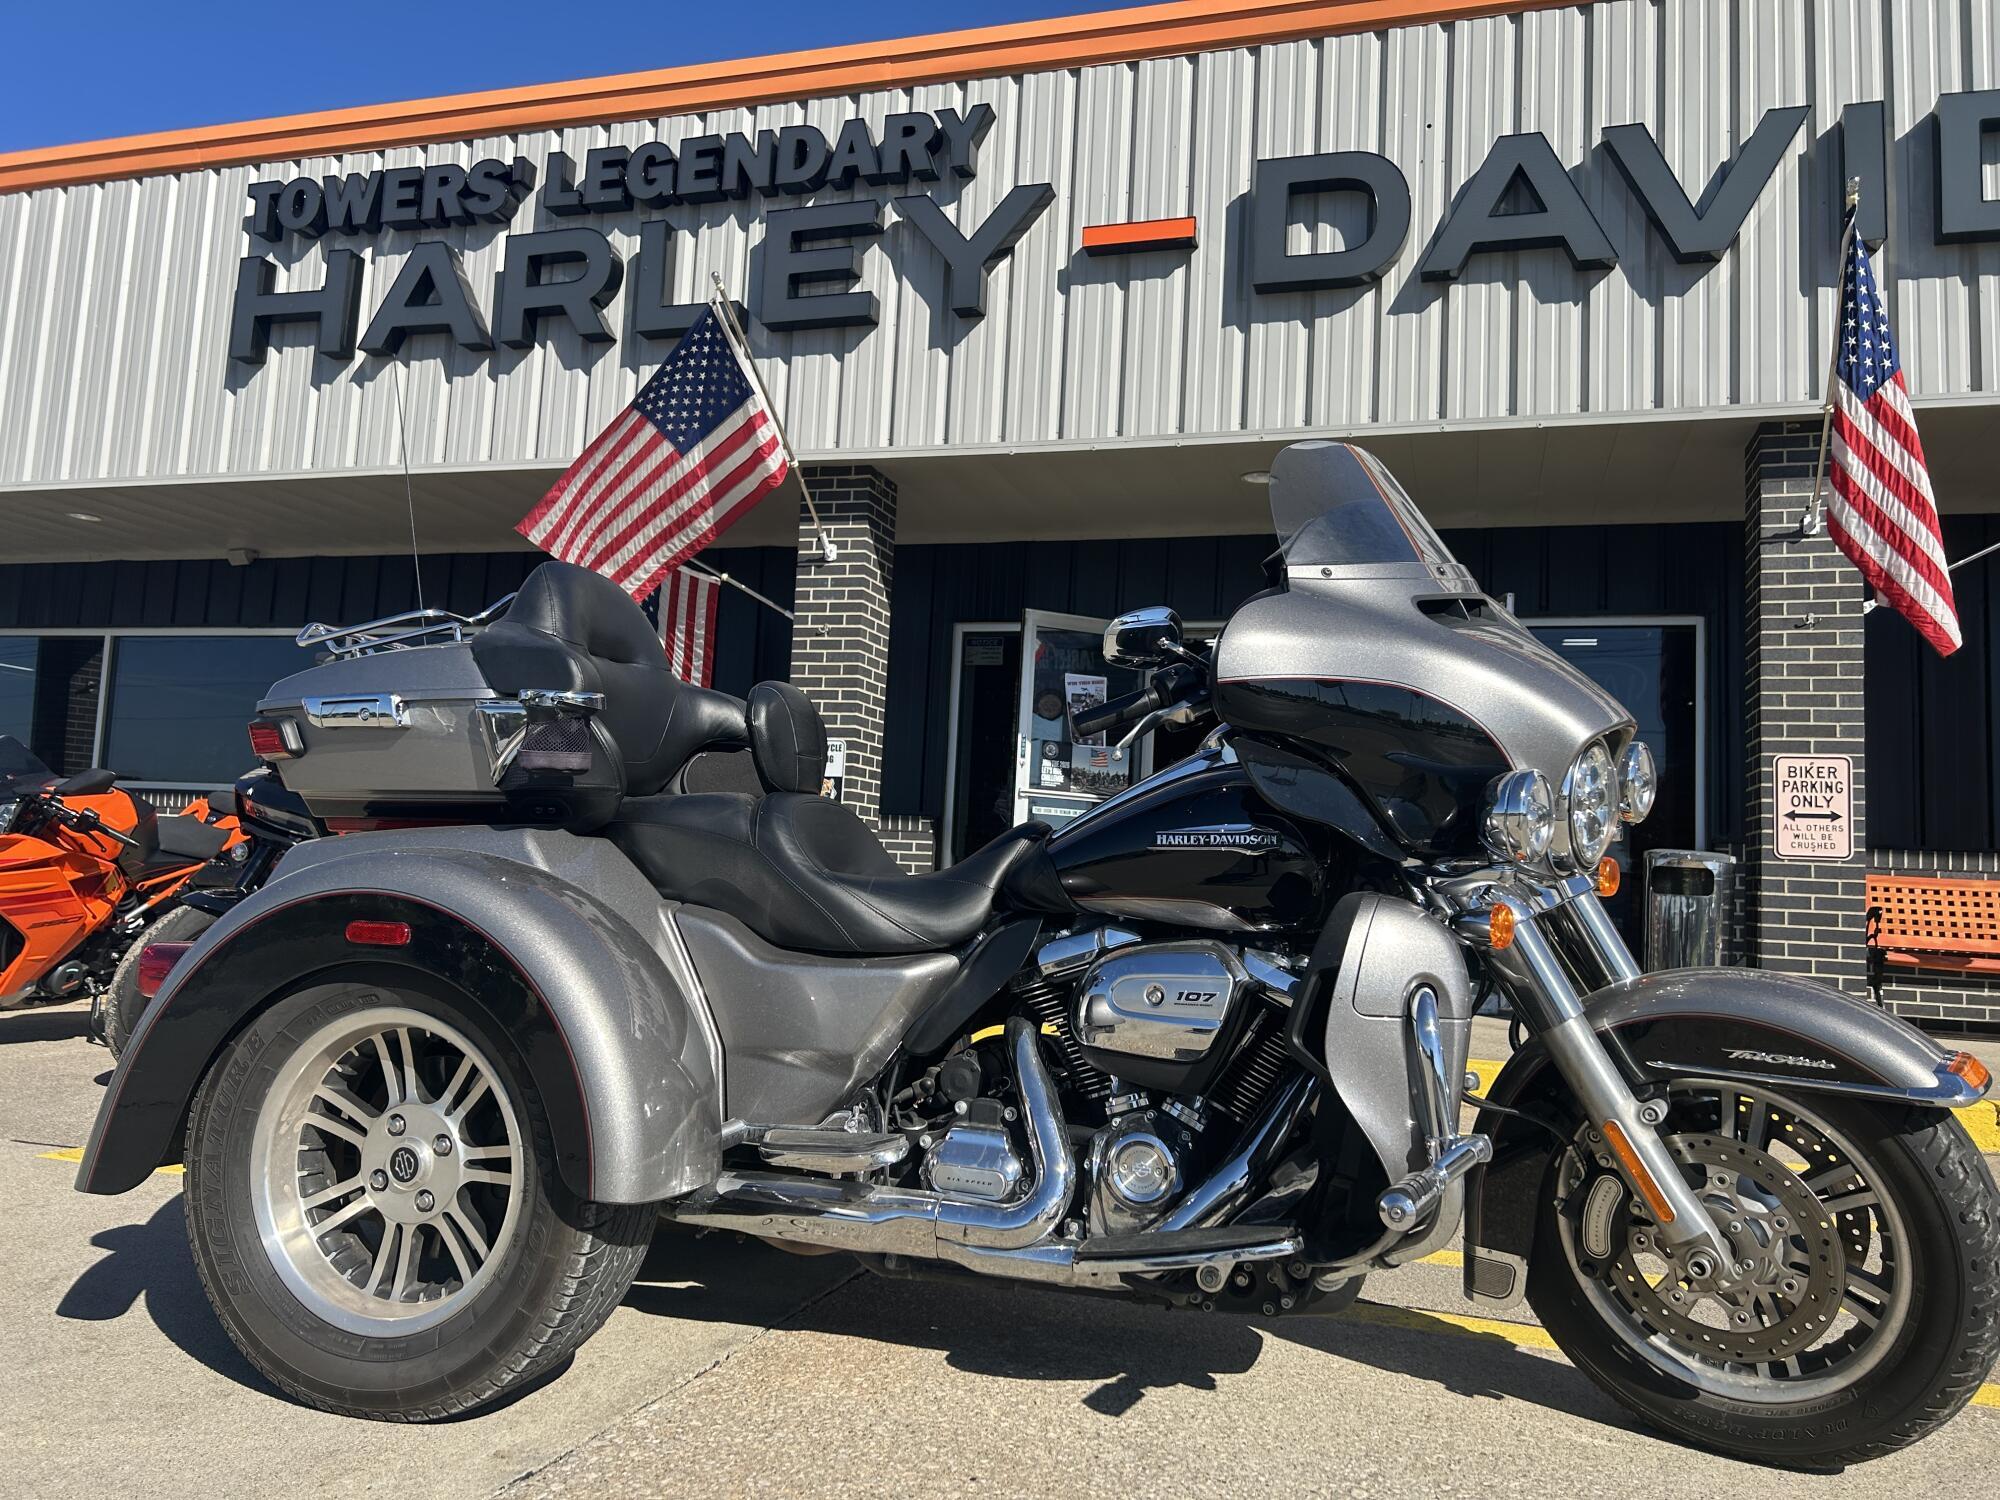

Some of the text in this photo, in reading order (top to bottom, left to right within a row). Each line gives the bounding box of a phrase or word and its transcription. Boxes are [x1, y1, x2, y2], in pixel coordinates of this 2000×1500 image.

[544, 103, 996, 216] LEGENDARY
[230, 183, 1056, 364] HARLEY
[1788, 766, 1838, 779] BIKER
[1782, 780, 1844, 794] PARKING
[1791, 795, 1834, 808] ONLY
[1806, 824, 1844, 832] OTHERS
[1156, 834, 1277, 845] HARLEY-DAVIDSON
[1791, 842, 1836, 850] CRUSHED
[1176, 991, 1218, 1002] 107
[203, 1029, 266, 1297] SIGNATURE
